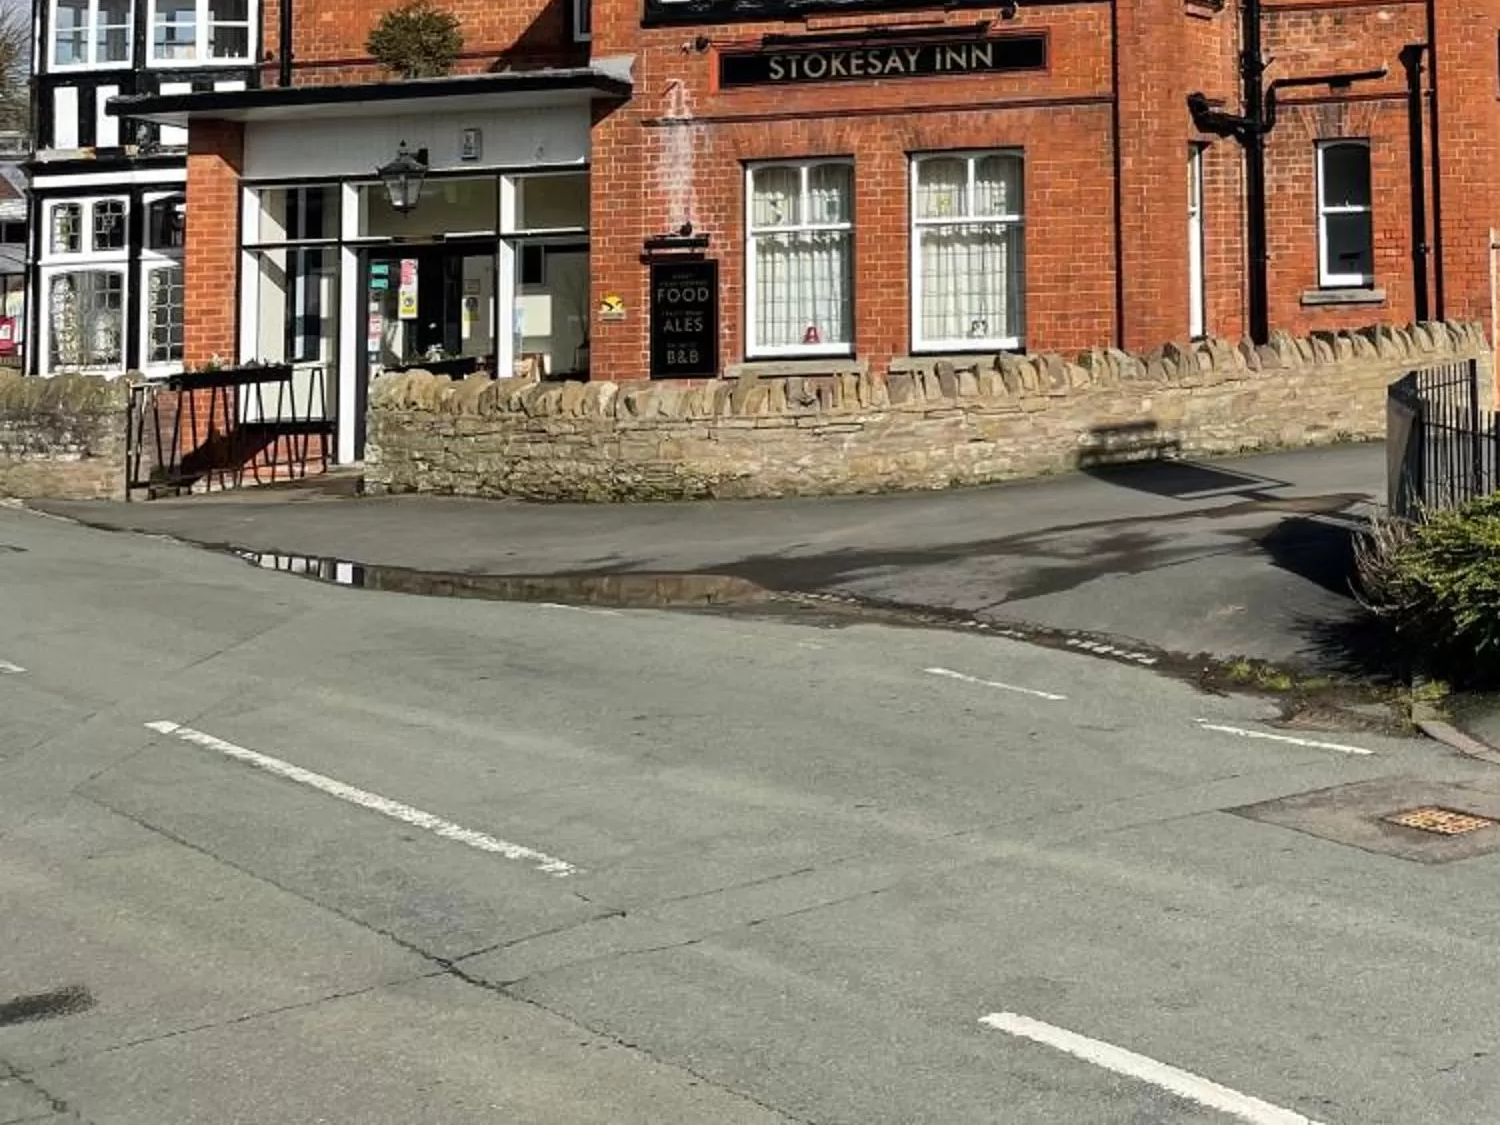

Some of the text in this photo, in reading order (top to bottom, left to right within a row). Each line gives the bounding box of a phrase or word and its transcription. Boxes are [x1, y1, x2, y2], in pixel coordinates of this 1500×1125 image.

[769, 43, 993, 80] STOKESAY INN
[657, 287, 709, 303] FOOD
[664, 317, 704, 332] ALES
[667, 350, 699, 364] B&B
